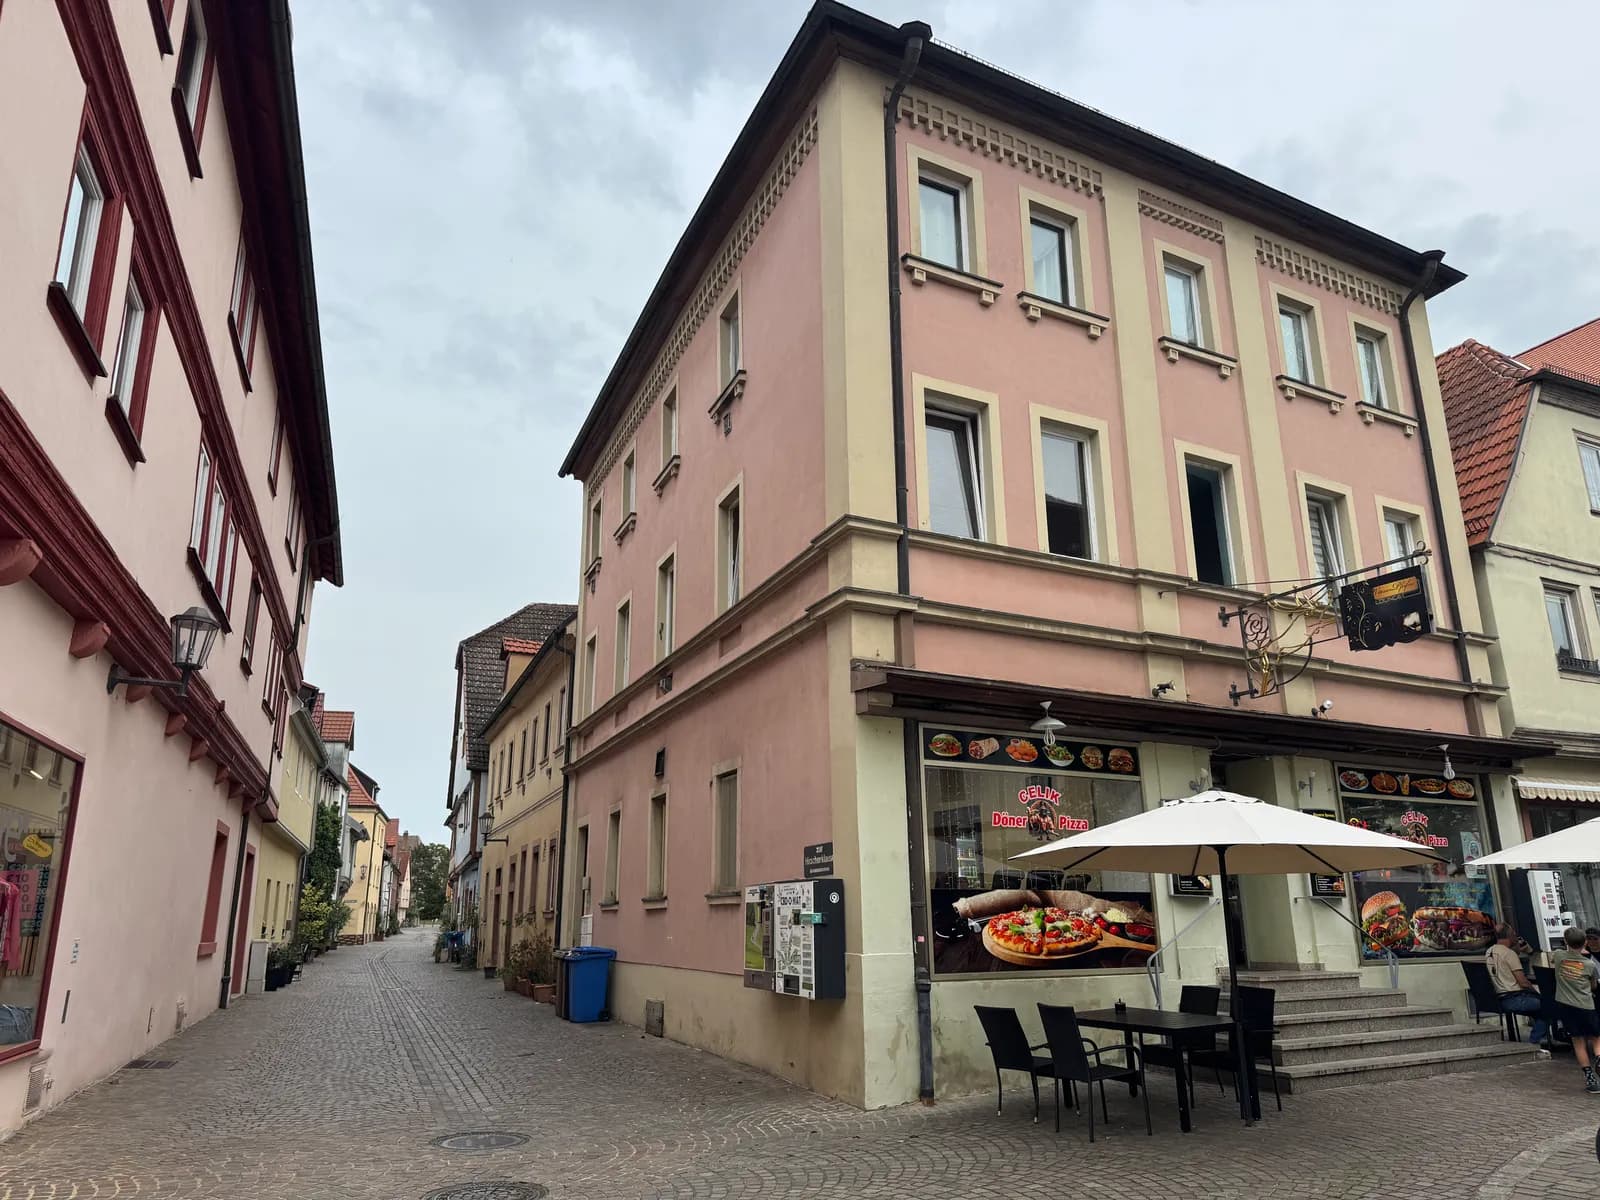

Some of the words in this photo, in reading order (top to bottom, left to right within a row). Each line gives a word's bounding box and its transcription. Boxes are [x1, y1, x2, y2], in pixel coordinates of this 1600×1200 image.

[1019, 786, 1060, 805] CELIK
[993, 812, 1027, 826] Döner
[1059, 815, 1088, 830] Pizza
[1428, 834, 1448, 847] Pizza
